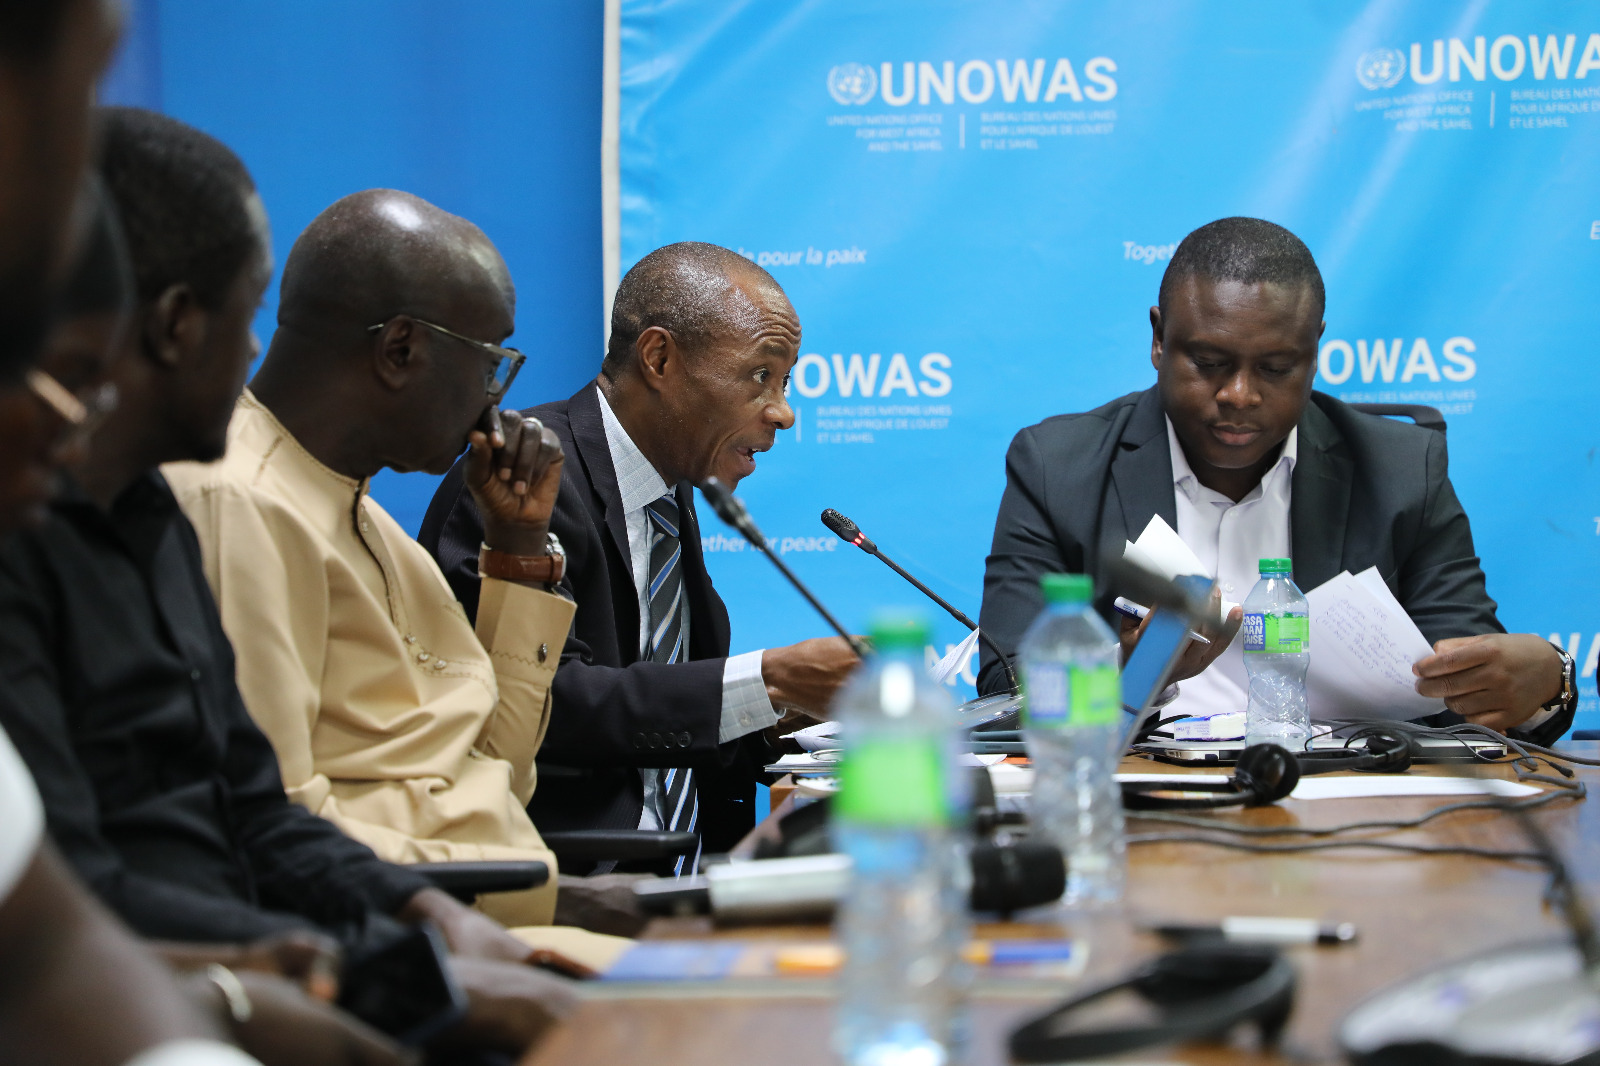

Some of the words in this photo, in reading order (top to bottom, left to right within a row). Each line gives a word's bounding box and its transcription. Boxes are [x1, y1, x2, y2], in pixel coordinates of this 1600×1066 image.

[881, 57, 1118, 107] UNOWAS
[1438, 89, 1474, 102] OFFICE
[1511, 88, 1549, 100] BUREAU
[1551, 88, 1571, 100] DES
[1435, 103, 1472, 116] AFRICA
[1510, 103, 1537, 114] POUR
[1441, 118, 1473, 130] SAHEL
[1509, 117, 1521, 128] ET
[1522, 117, 1535, 128] LE
[1536, 116, 1569, 128] SAHEL
[757, 251, 803, 266] pour
[805, 246, 823, 265] la
[825, 246, 867, 268] paix
[1122, 241, 1181, 265] Toget
[785, 352, 952, 398] OWAS
[779, 537, 838, 556] peace
